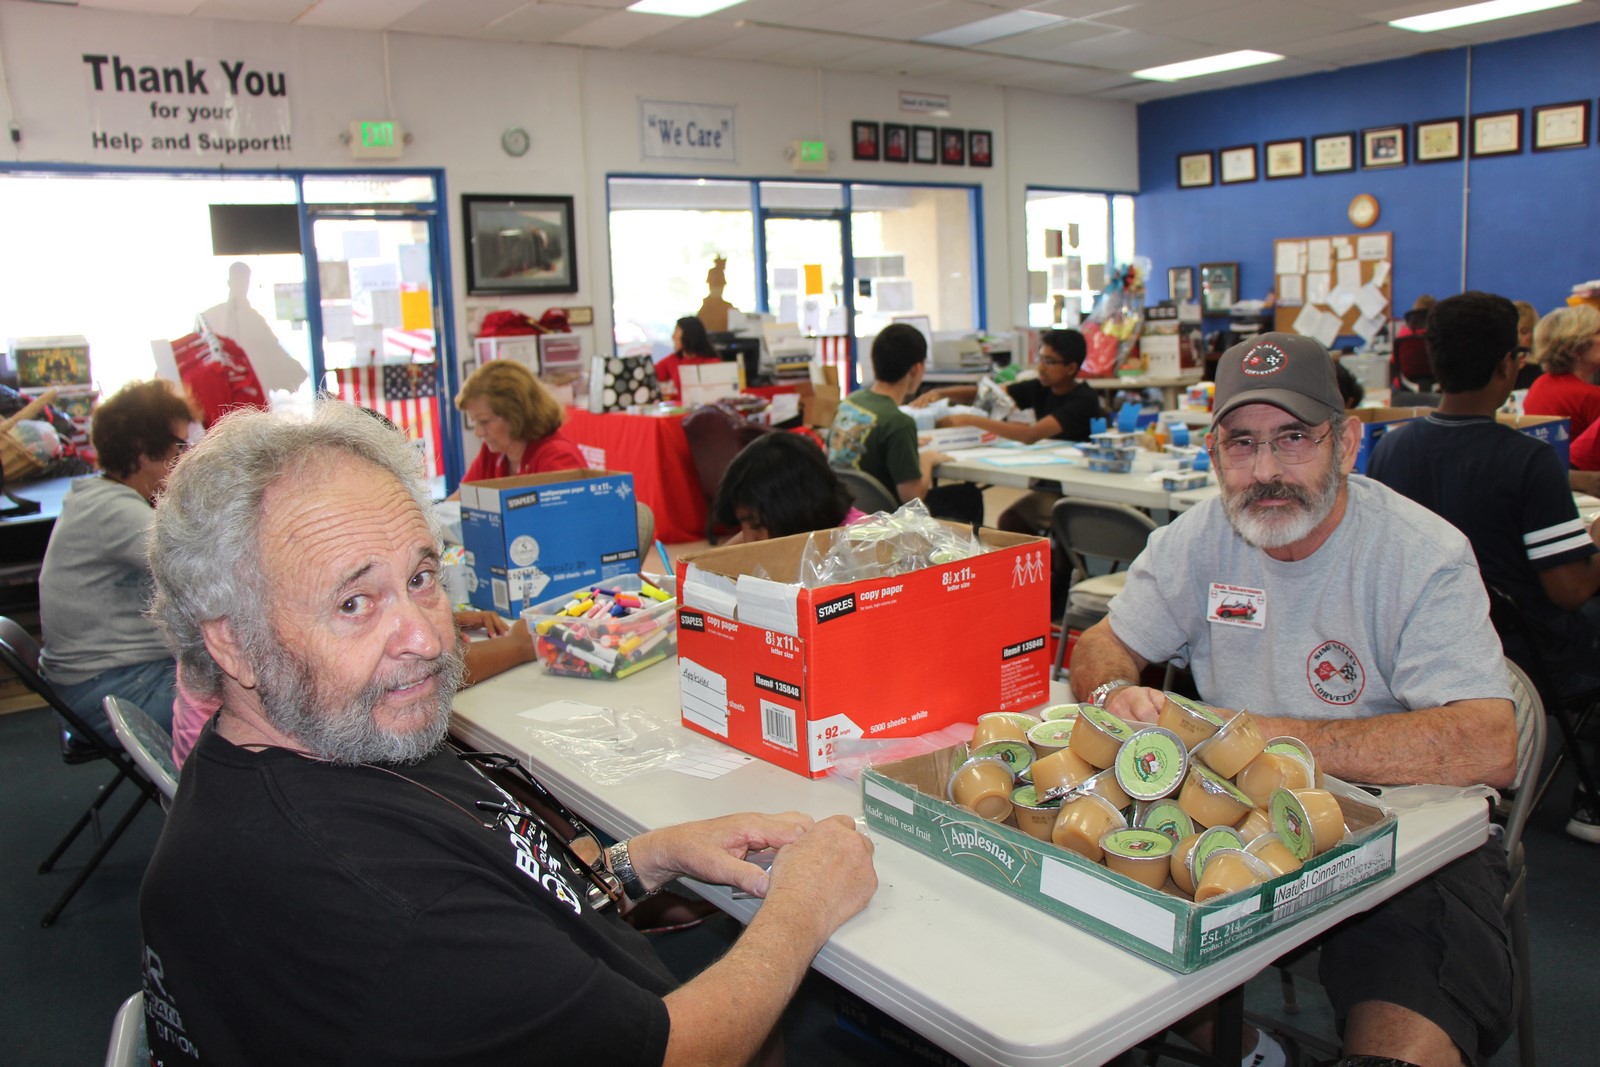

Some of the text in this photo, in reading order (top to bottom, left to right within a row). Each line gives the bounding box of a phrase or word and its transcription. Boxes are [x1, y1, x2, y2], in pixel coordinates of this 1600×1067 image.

[82, 54, 286, 97] Thank You
[150, 101, 233, 123] for your
[92, 131, 292, 154] Help and Support!!
[361, 121, 394, 147] EXIT
[507, 493, 537, 509] STAPLES
[860, 584, 903, 602] copy paper
[818, 598, 853, 618] STAPLES
[681, 615, 739, 632] STAPLES copy paper
[771, 647, 793, 660] letter size
[1022, 637, 1044, 651] 135848
[775, 682, 799, 697] 135848
[729, 700, 745, 712] sheets
[825, 725, 838, 740] 92
[870, 710, 928, 734] 5000 sheets white
[865, 803, 931, 842] Made with real fruit
[951, 827, 1016, 870] Applesnax
[1311, 854, 1356, 885] Cinnamon
[1199, 943, 1223, 956] Product
[1231, 928, 1253, 942] Canada
[1201, 920, 1240, 947] Est. 214
